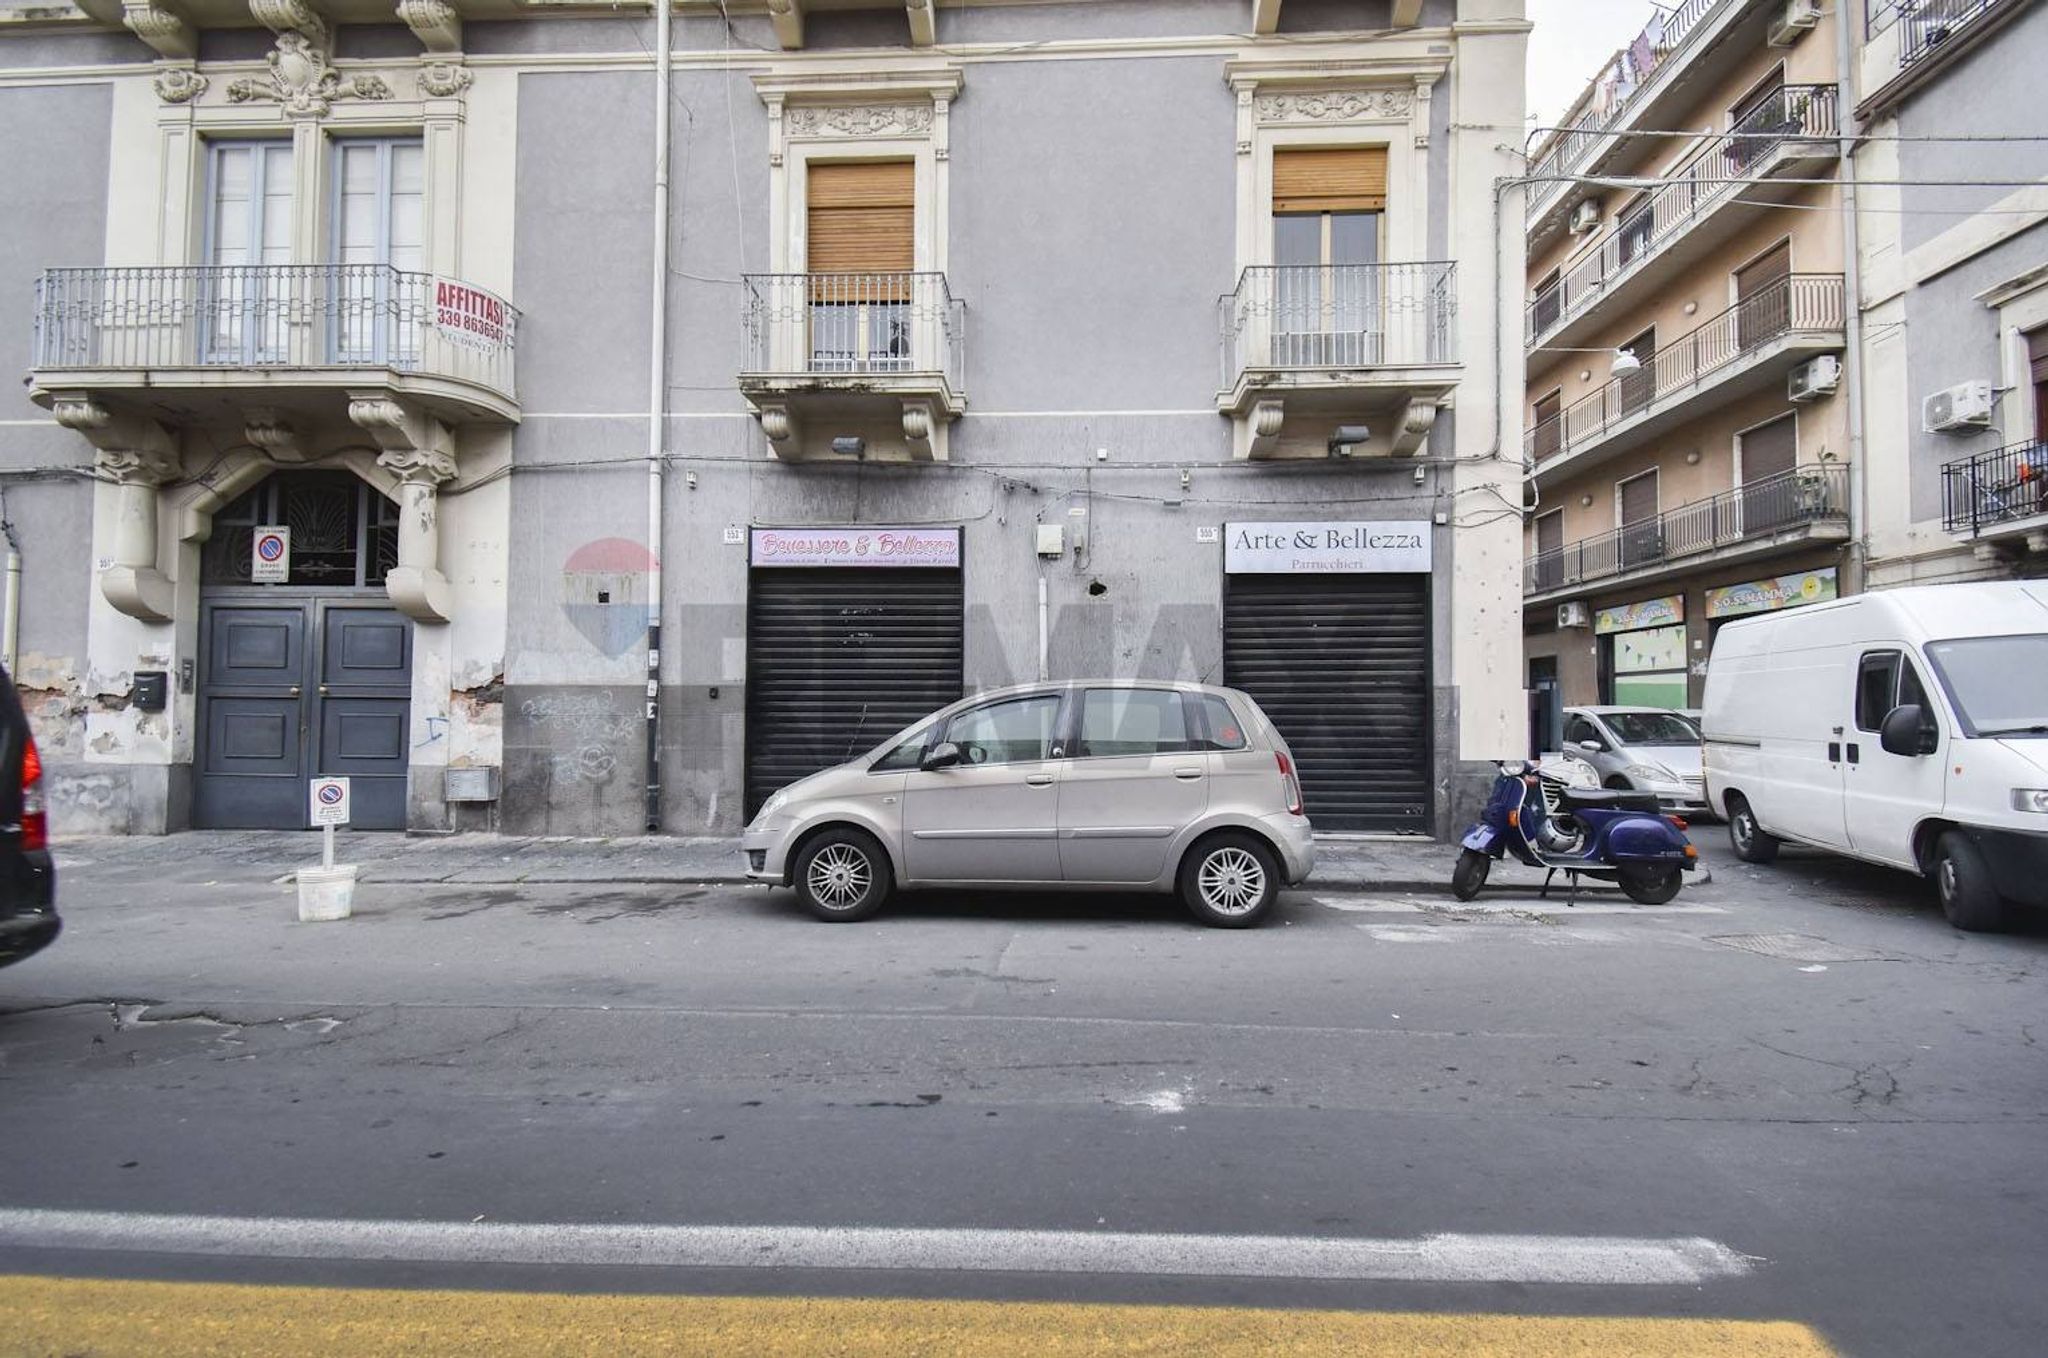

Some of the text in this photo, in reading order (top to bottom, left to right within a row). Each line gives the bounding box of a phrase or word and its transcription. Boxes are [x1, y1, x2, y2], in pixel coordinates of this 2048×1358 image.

[436, 281, 504, 328] AFFITTASI
[437, 308, 461, 328] 339
[760, 533, 957, 556] Benessere & Bellezza
[1234, 529, 1423, 550] Arte & Bellezza
[1291, 559, 1364, 570] Parrucchieri
